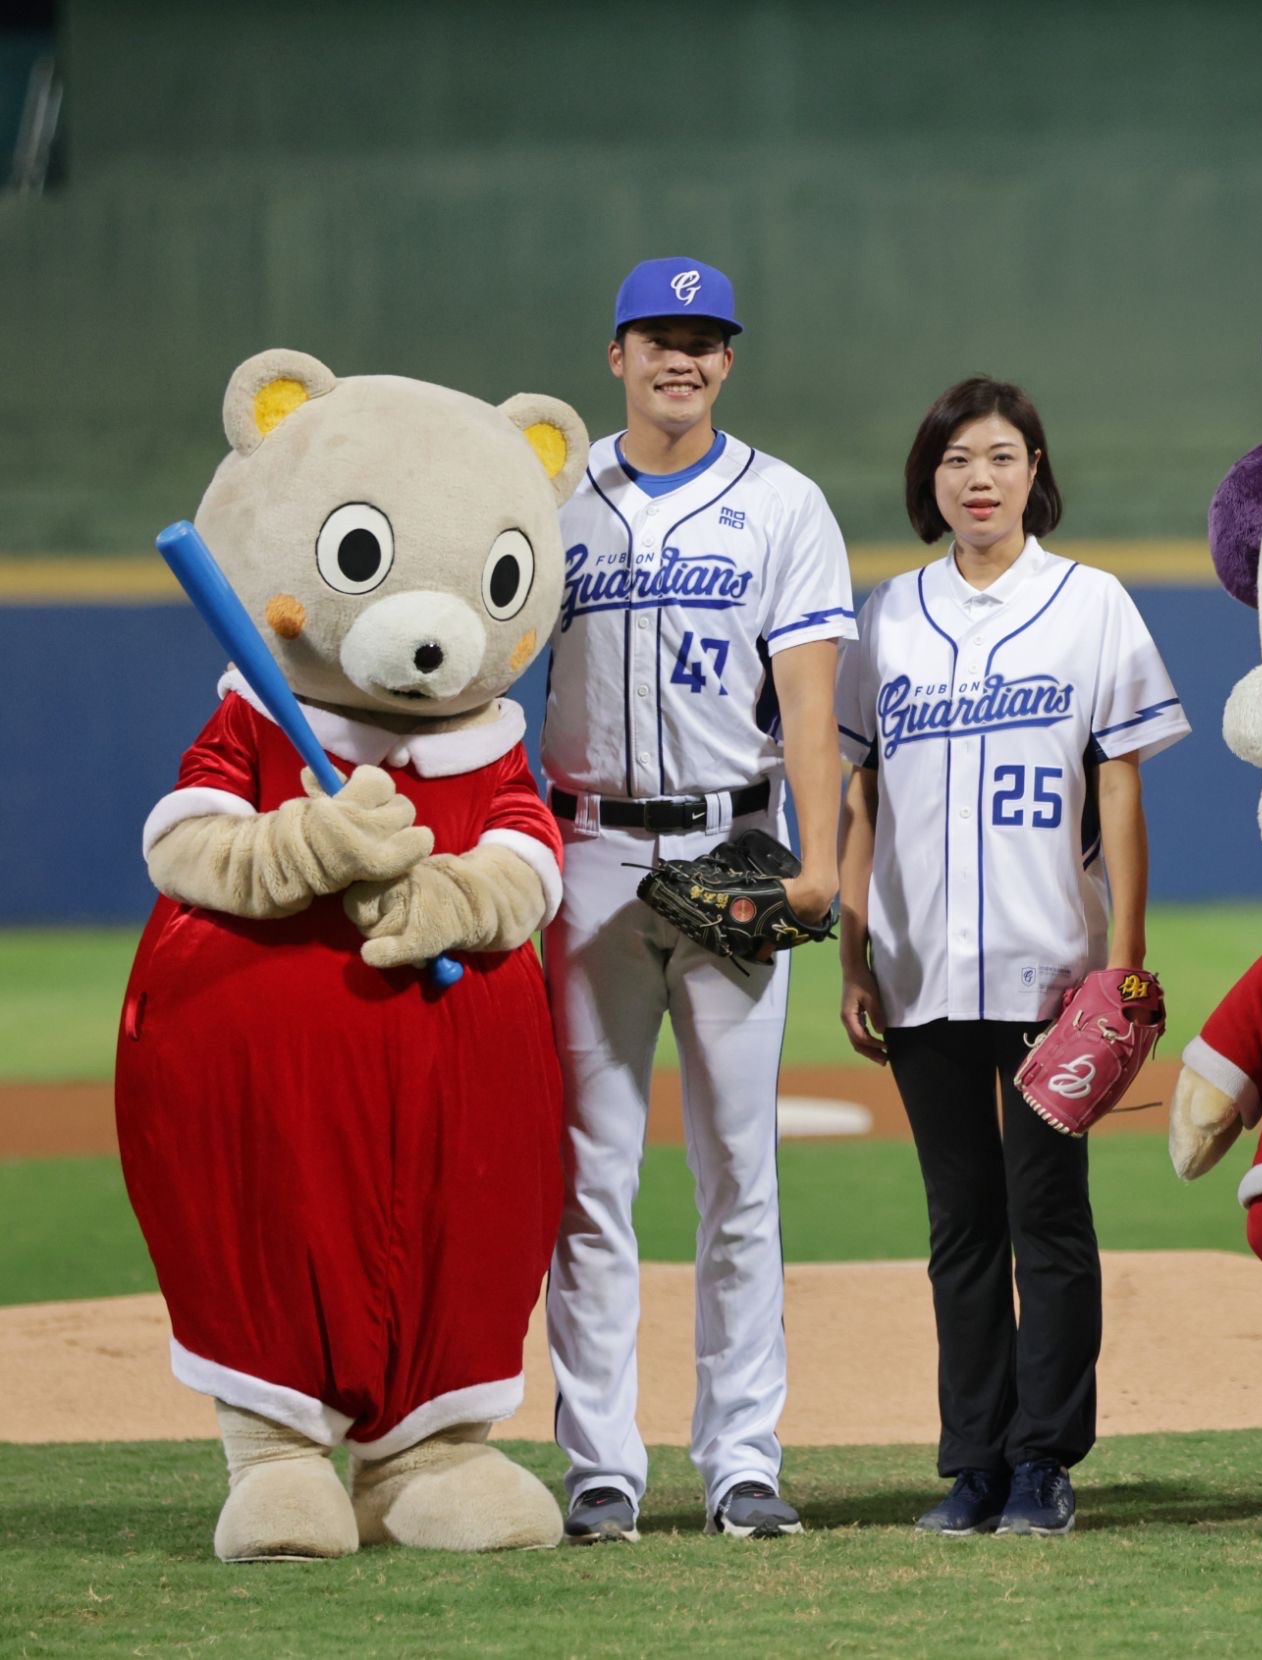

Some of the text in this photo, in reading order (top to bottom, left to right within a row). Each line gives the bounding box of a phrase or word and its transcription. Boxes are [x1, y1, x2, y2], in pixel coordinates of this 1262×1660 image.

[561, 543, 753, 633] Guardians
[670, 631, 730, 696] 47
[914, 681, 981, 697] FUBON
[878, 674, 1074, 760] Guardians
[992, 764, 1063, 828] 25
